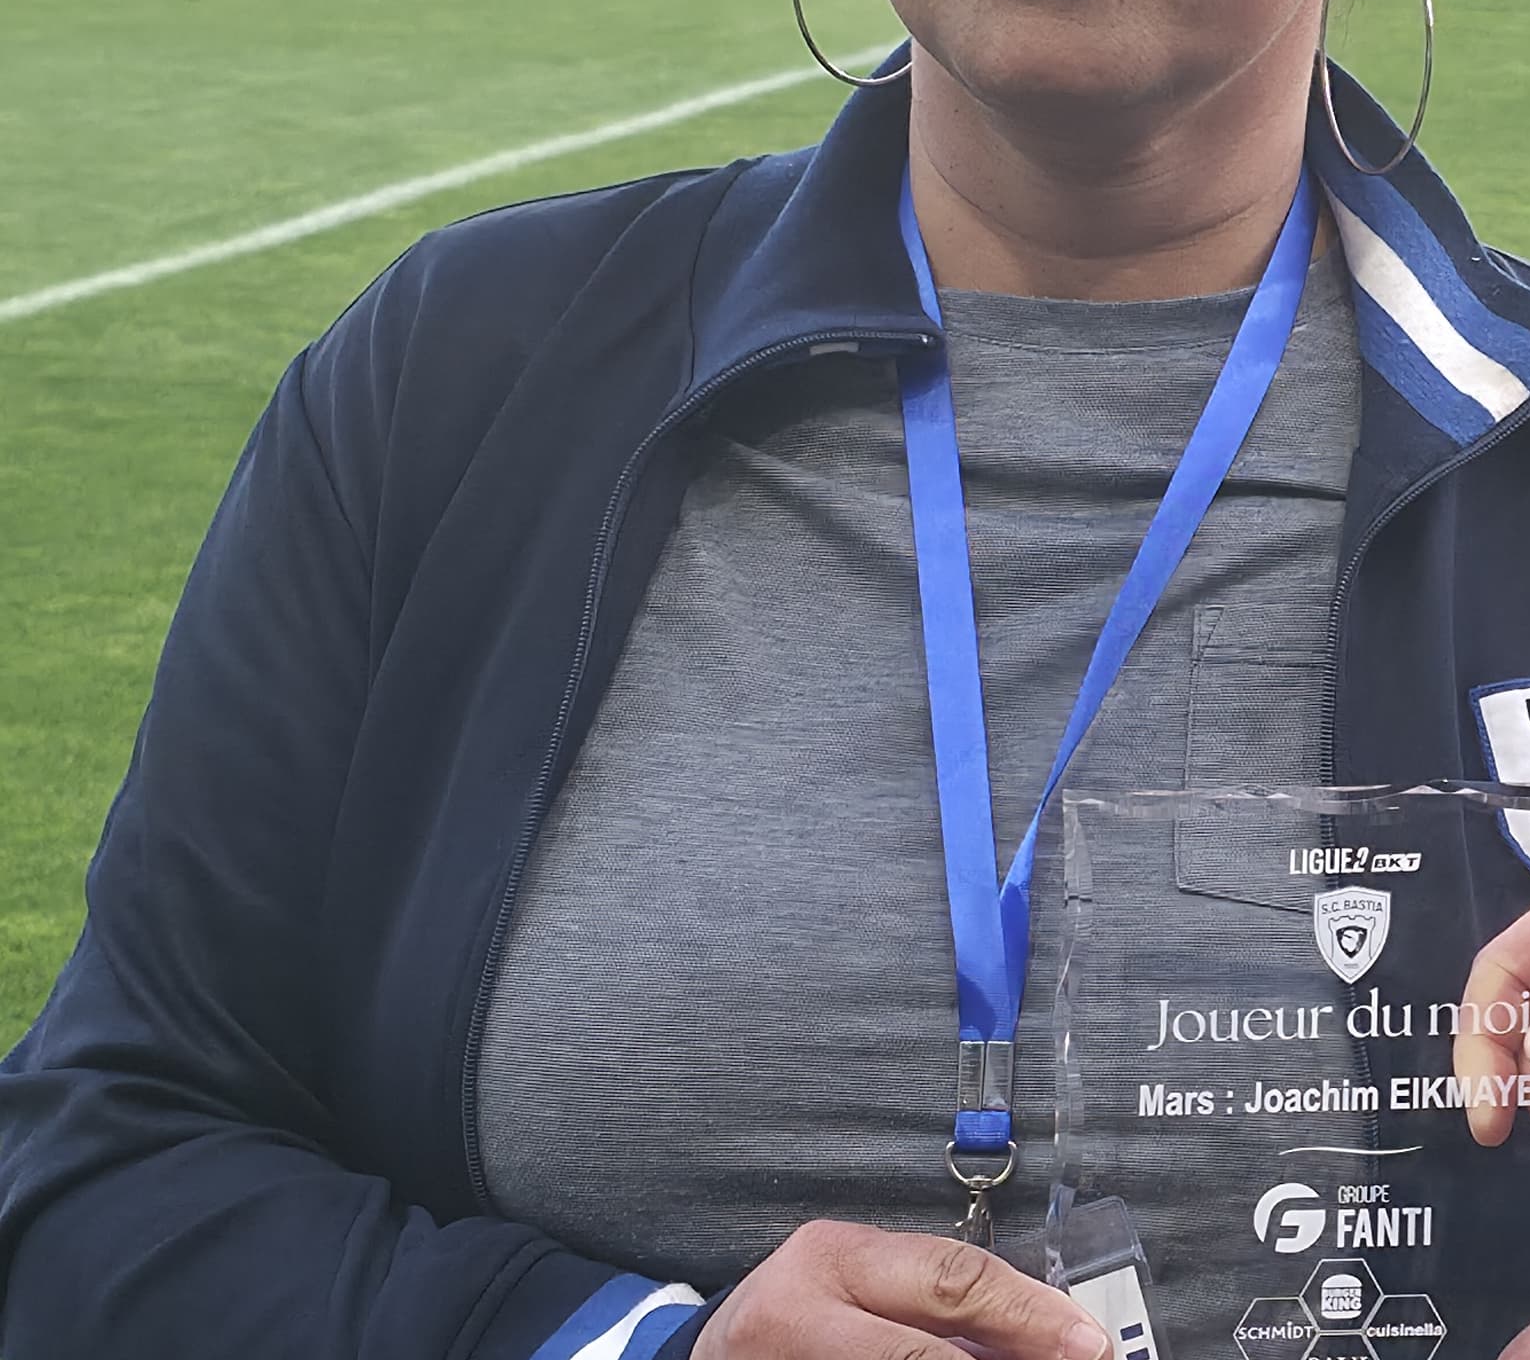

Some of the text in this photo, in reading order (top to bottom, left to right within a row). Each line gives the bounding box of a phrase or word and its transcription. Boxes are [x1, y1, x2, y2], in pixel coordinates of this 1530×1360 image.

[1373, 855, 1419, 870] BKT
[1344, 900, 1383, 912] BASTIA
[1147, 1000, 1333, 1051] Joueur
[1346, 987, 1412, 1039] du
[1139, 1083, 1214, 1117] Mars
[1245, 1078, 1379, 1114] Joachim
[1338, 1184, 1390, 1204] GROUPE
[1336, 1207, 1432, 1248] FANTI
[1322, 1296, 1362, 1311] KING
[1238, 1321, 1314, 1340] SCHMIDT
[1366, 1323, 1444, 1337] cuisinella
